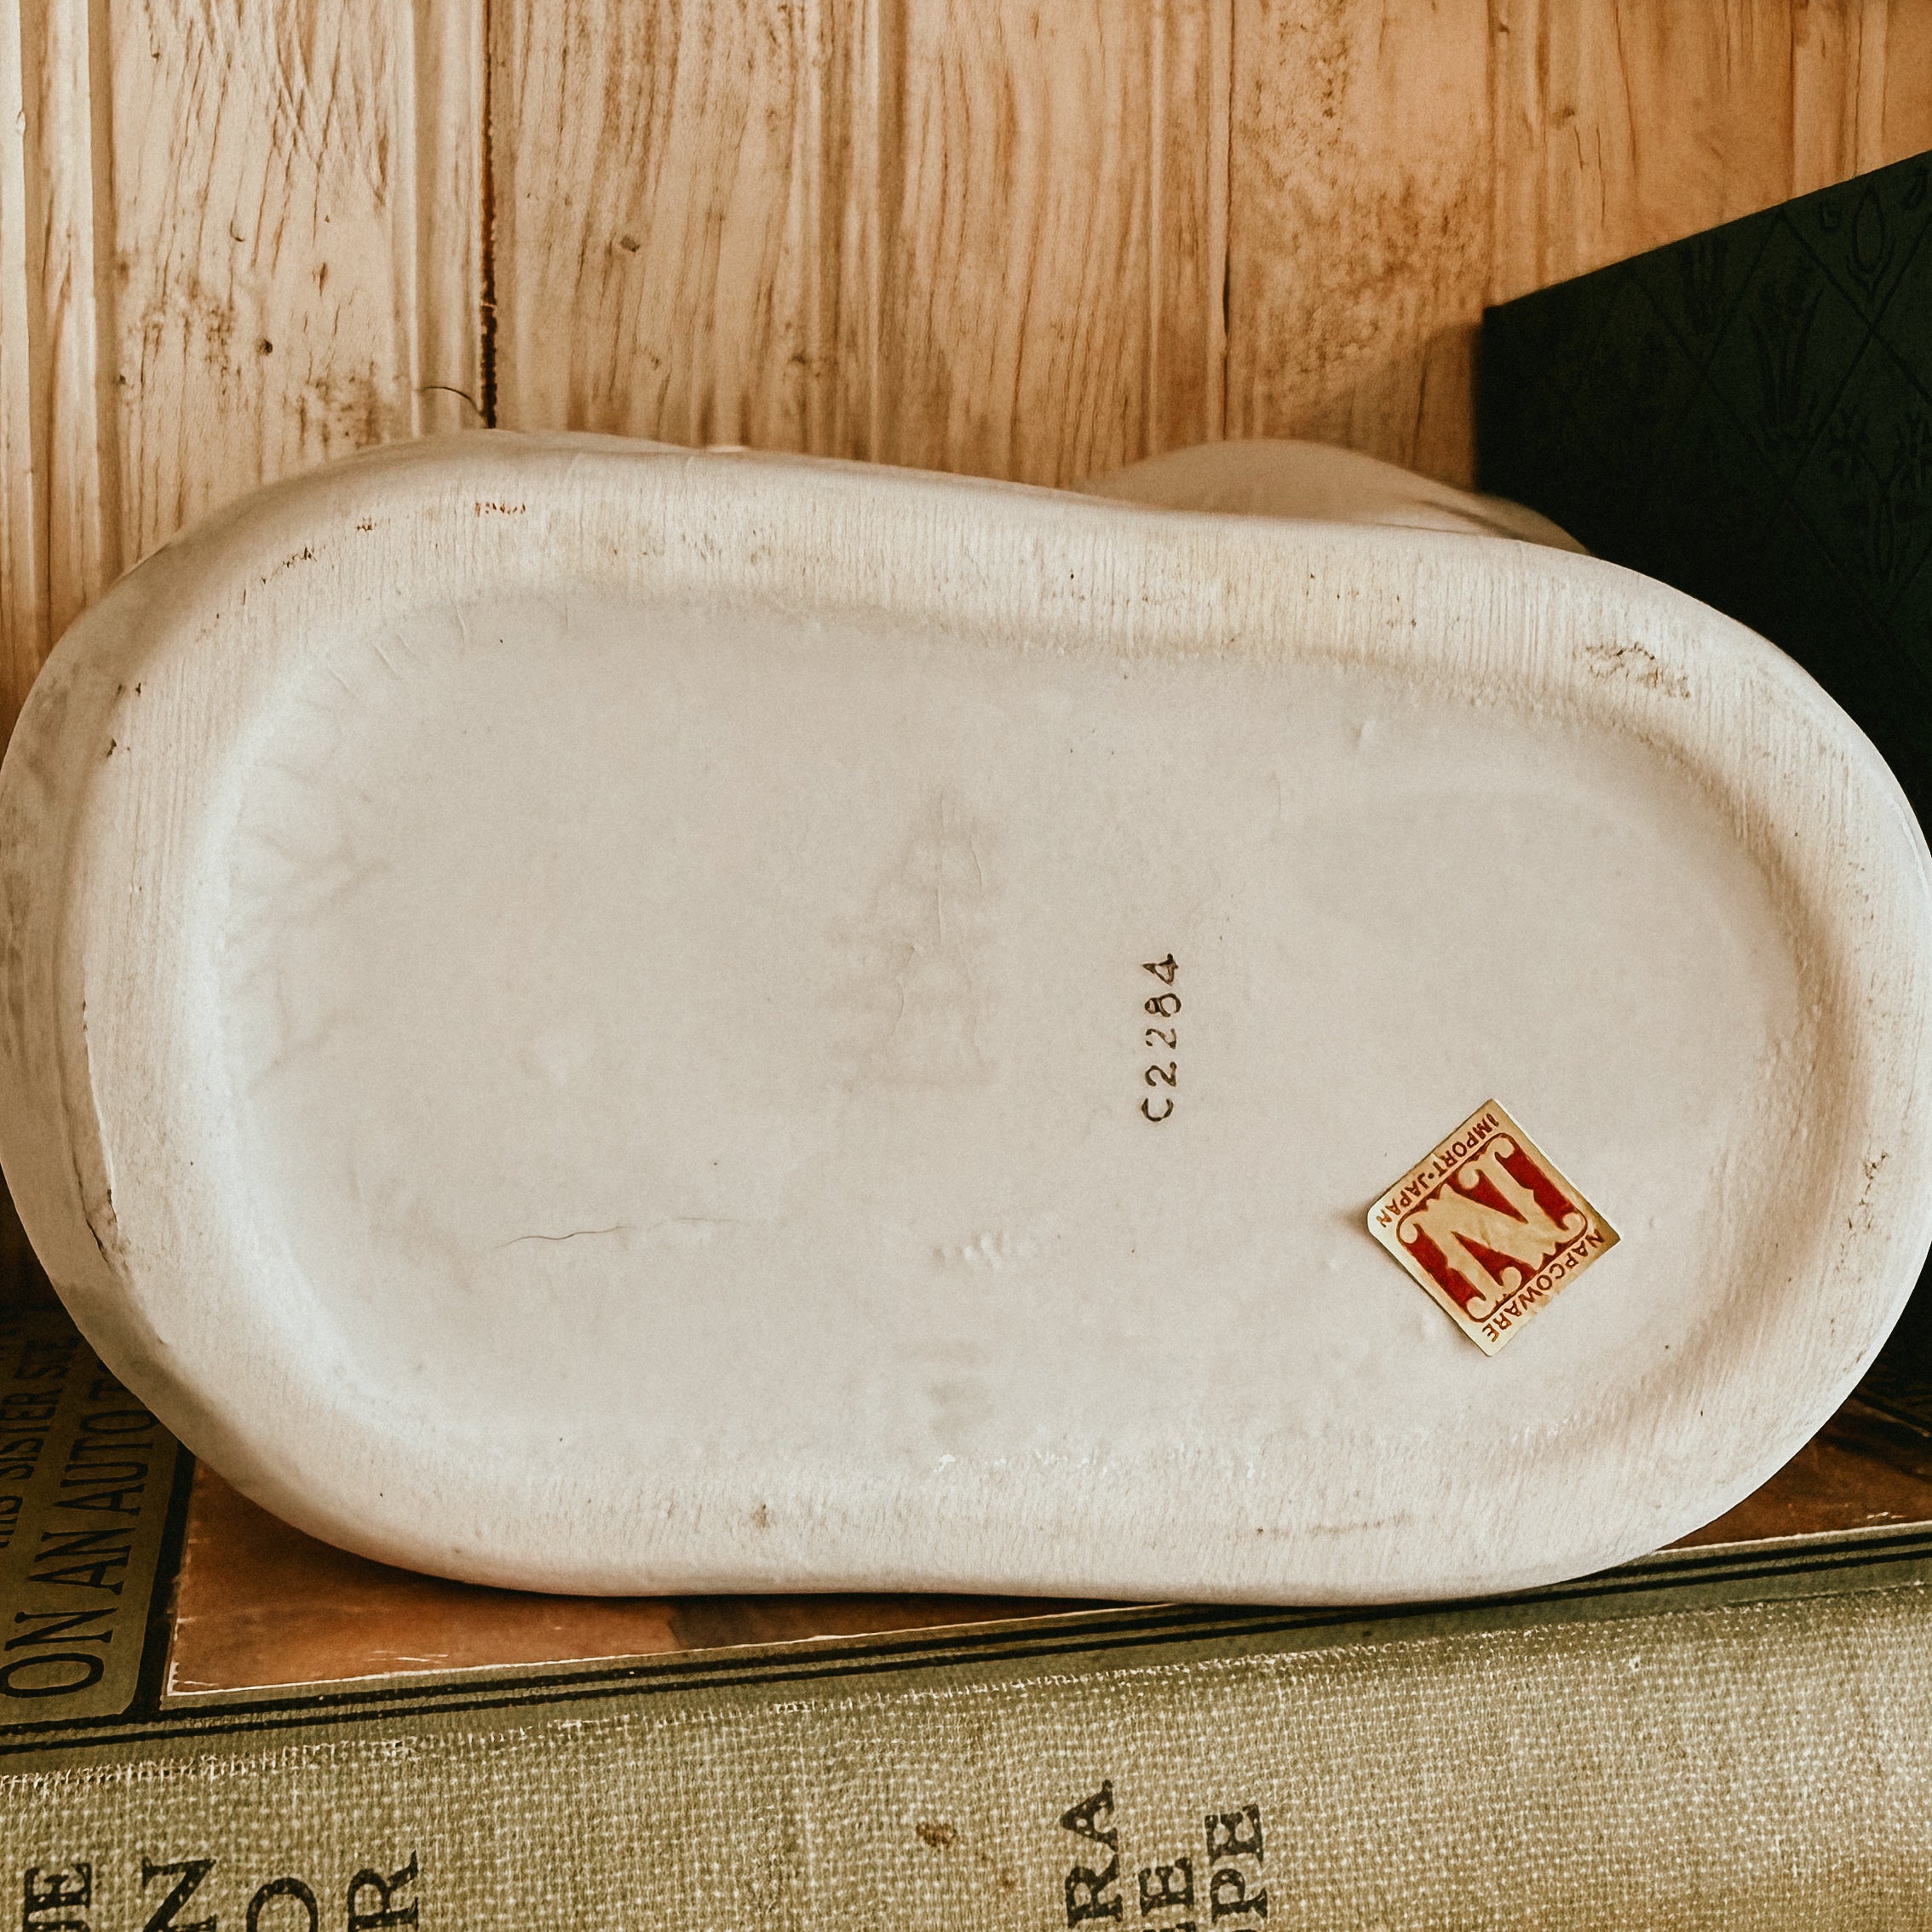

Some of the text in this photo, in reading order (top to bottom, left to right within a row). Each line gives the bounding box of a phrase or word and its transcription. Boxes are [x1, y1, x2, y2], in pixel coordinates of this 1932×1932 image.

[1141, 953, 1182, 1123] C2284
[1482, 1228, 1606, 1343] NAPCOWARE
[0, 1410, 160, 1699] ON AN AUTO
[347, 1849, 419, 1932] R
[1060, 1779, 1124, 1929] RA
[1138, 1857, 1196, 1932] E
[1204, 1803, 1268, 1932] PE
